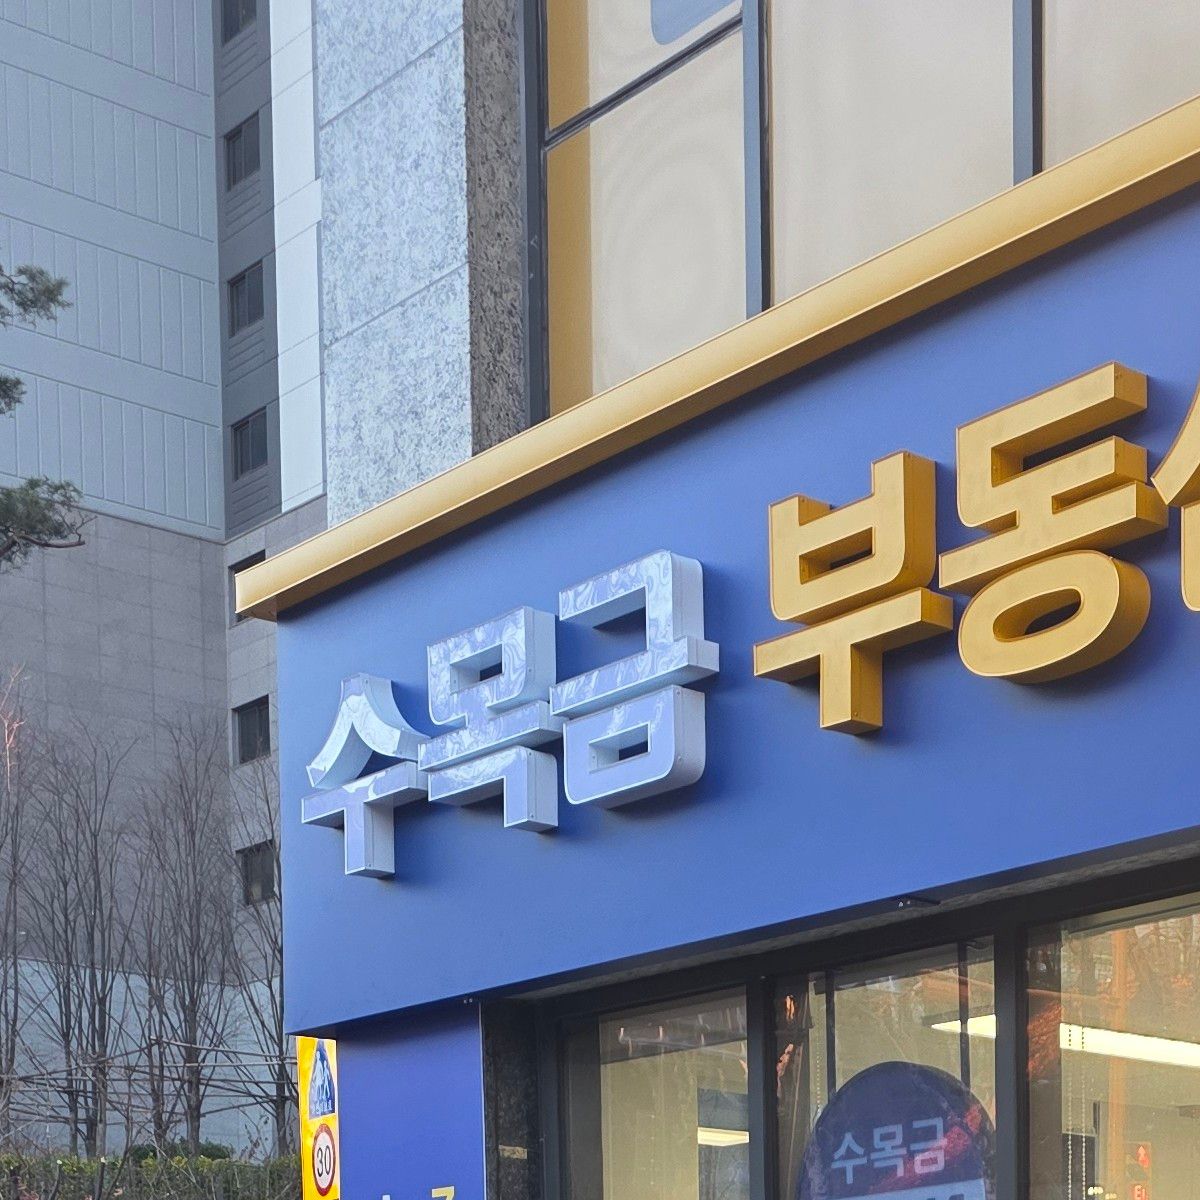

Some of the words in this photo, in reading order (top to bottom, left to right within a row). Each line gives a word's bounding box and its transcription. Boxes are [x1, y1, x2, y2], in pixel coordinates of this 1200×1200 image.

[301, 549, 720, 878] 수목금
[317, 1144, 331, 1178] 30
[831, 1117, 945, 1184] 수목금
